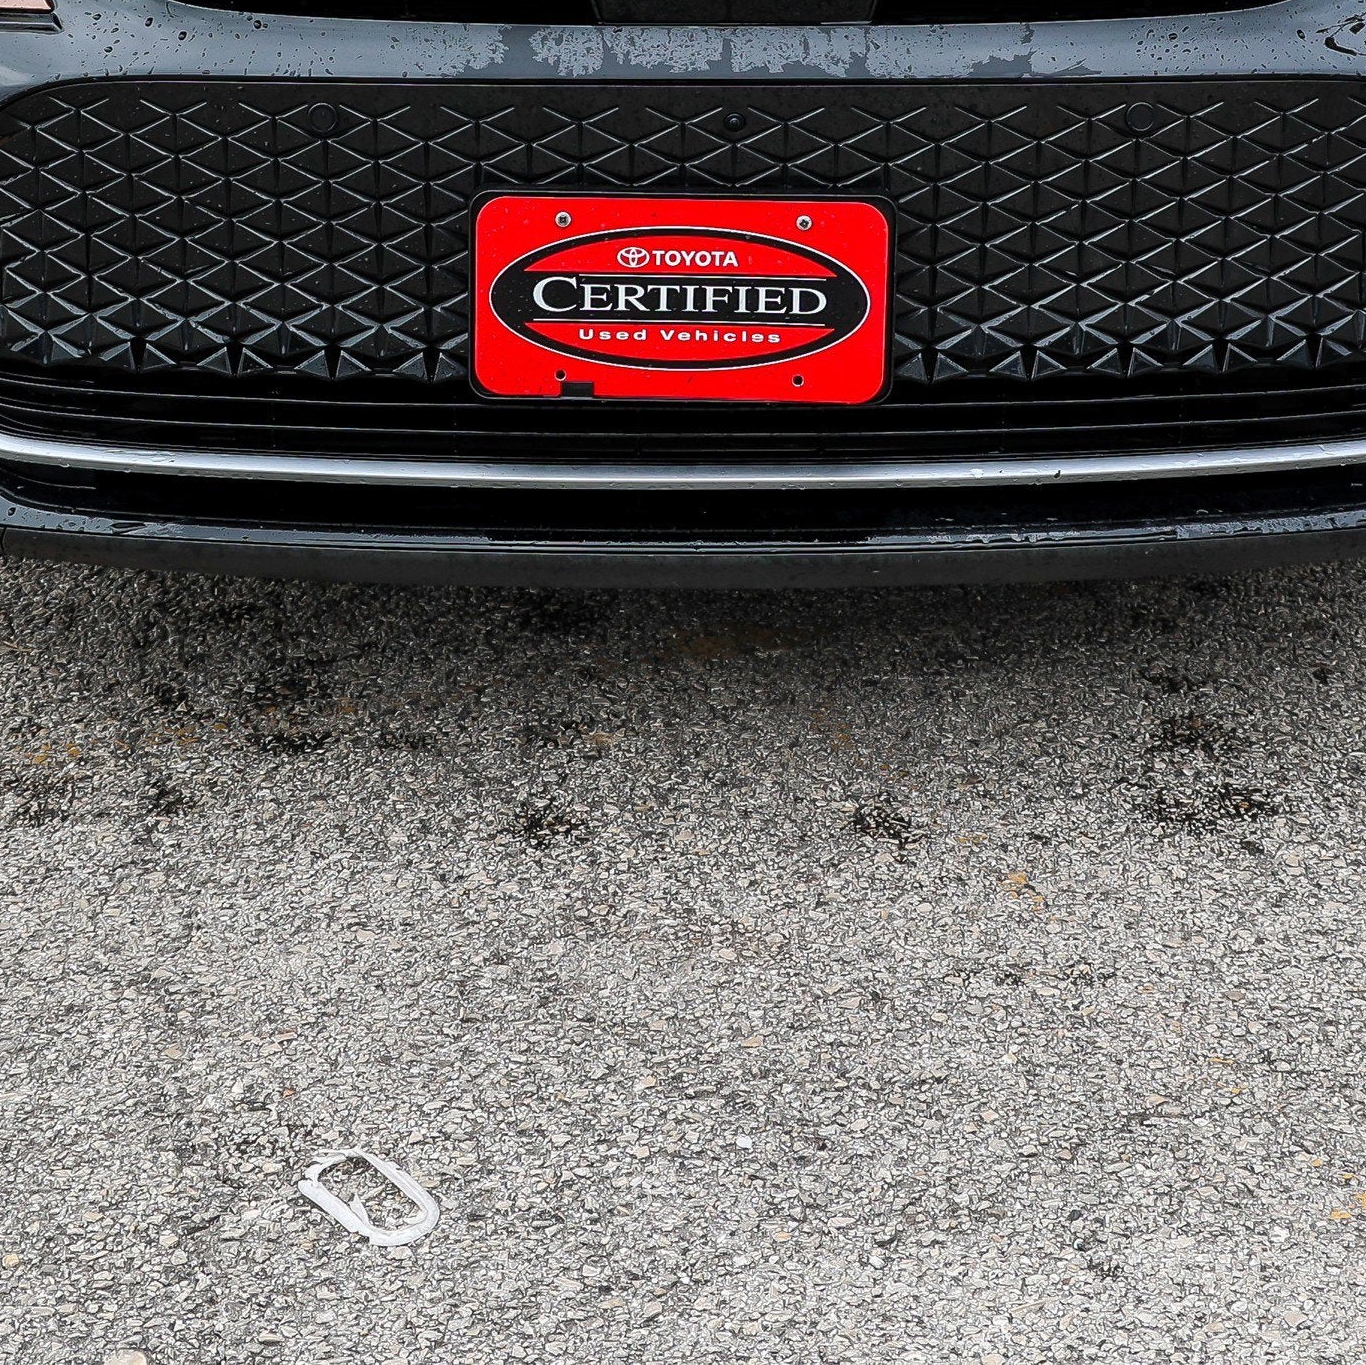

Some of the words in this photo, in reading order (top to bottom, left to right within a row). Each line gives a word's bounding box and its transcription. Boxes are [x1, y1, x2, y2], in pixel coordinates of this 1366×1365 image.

[653, 250, 739, 268] TOYOTA
[533, 276, 827, 315] CERTIFIED
[578, 328, 647, 341] Used
[660, 329, 781, 344] Vehicles
